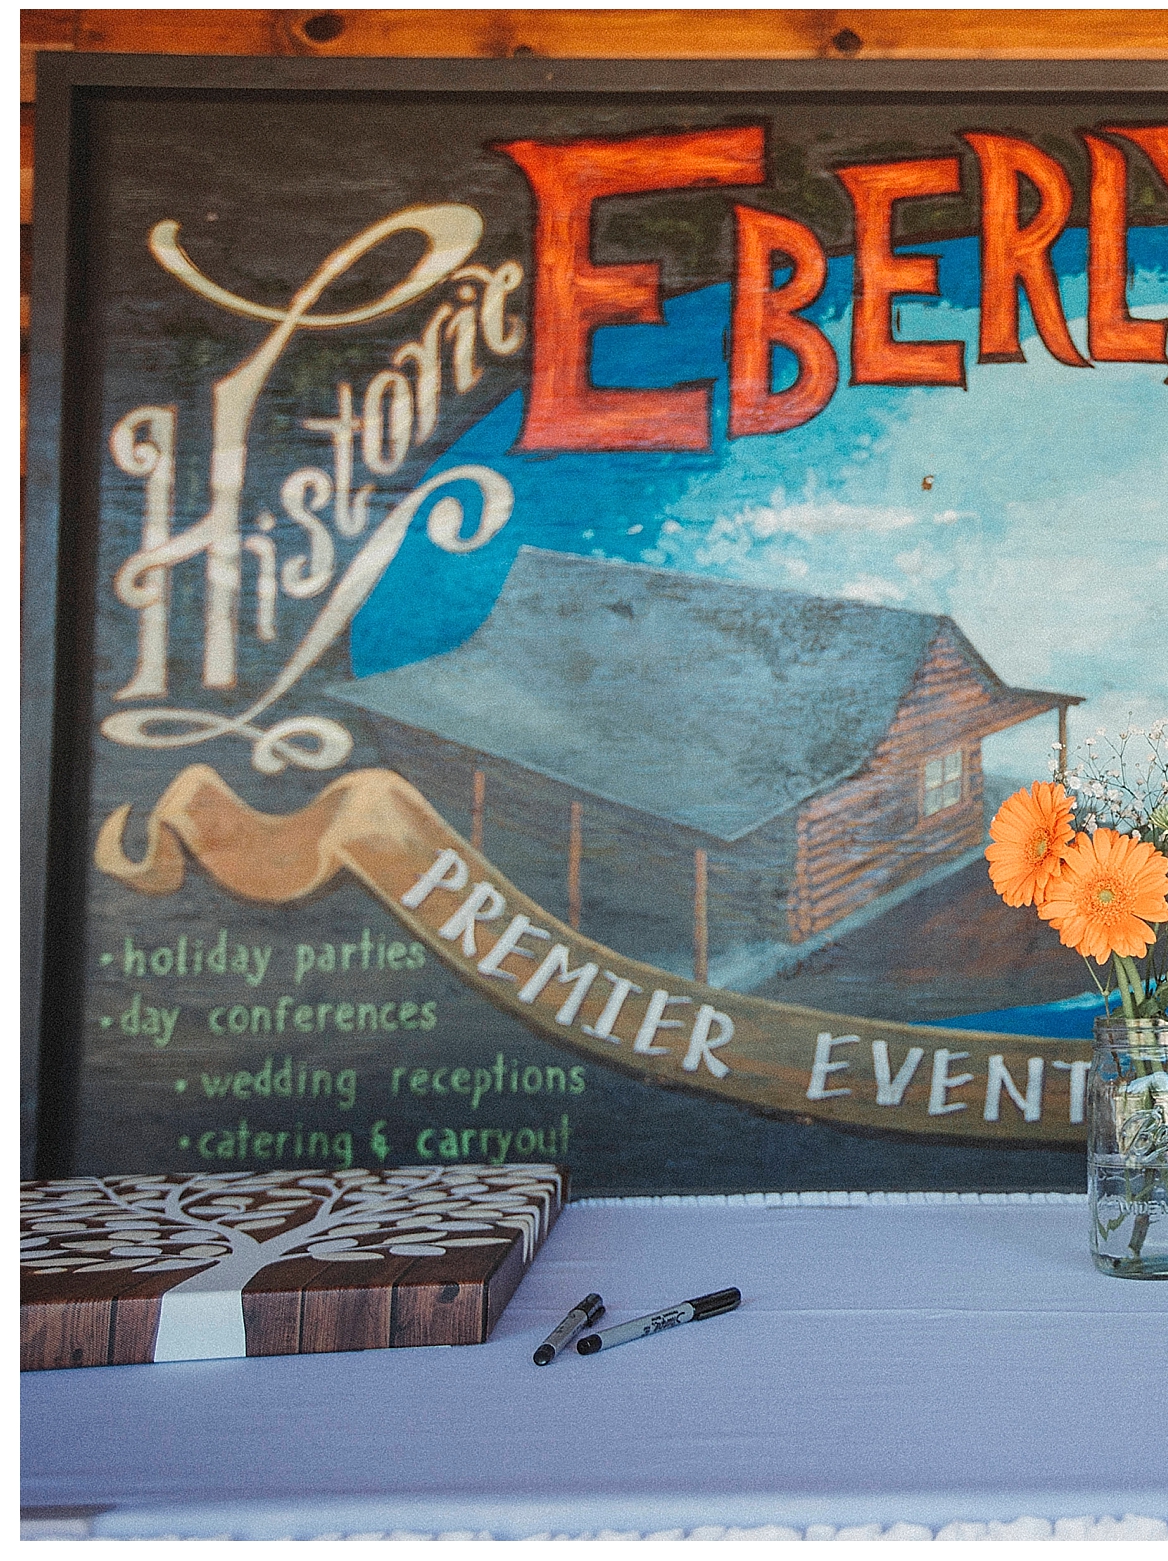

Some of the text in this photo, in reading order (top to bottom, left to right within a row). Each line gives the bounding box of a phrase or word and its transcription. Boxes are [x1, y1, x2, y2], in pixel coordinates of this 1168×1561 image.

[110, 202, 526, 702] Historic
[123, 927, 426, 987] holiday parties
[401, 847, 736, 1078] PREMIER
[806, 1032, 1092, 1125] EVENT
[119, 994, 438, 1047] day conferences
[202, 1053, 587, 1110] wedding receptions
[201, 1119, 352, 1168] catering
[416, 1114, 572, 1164] carryout
